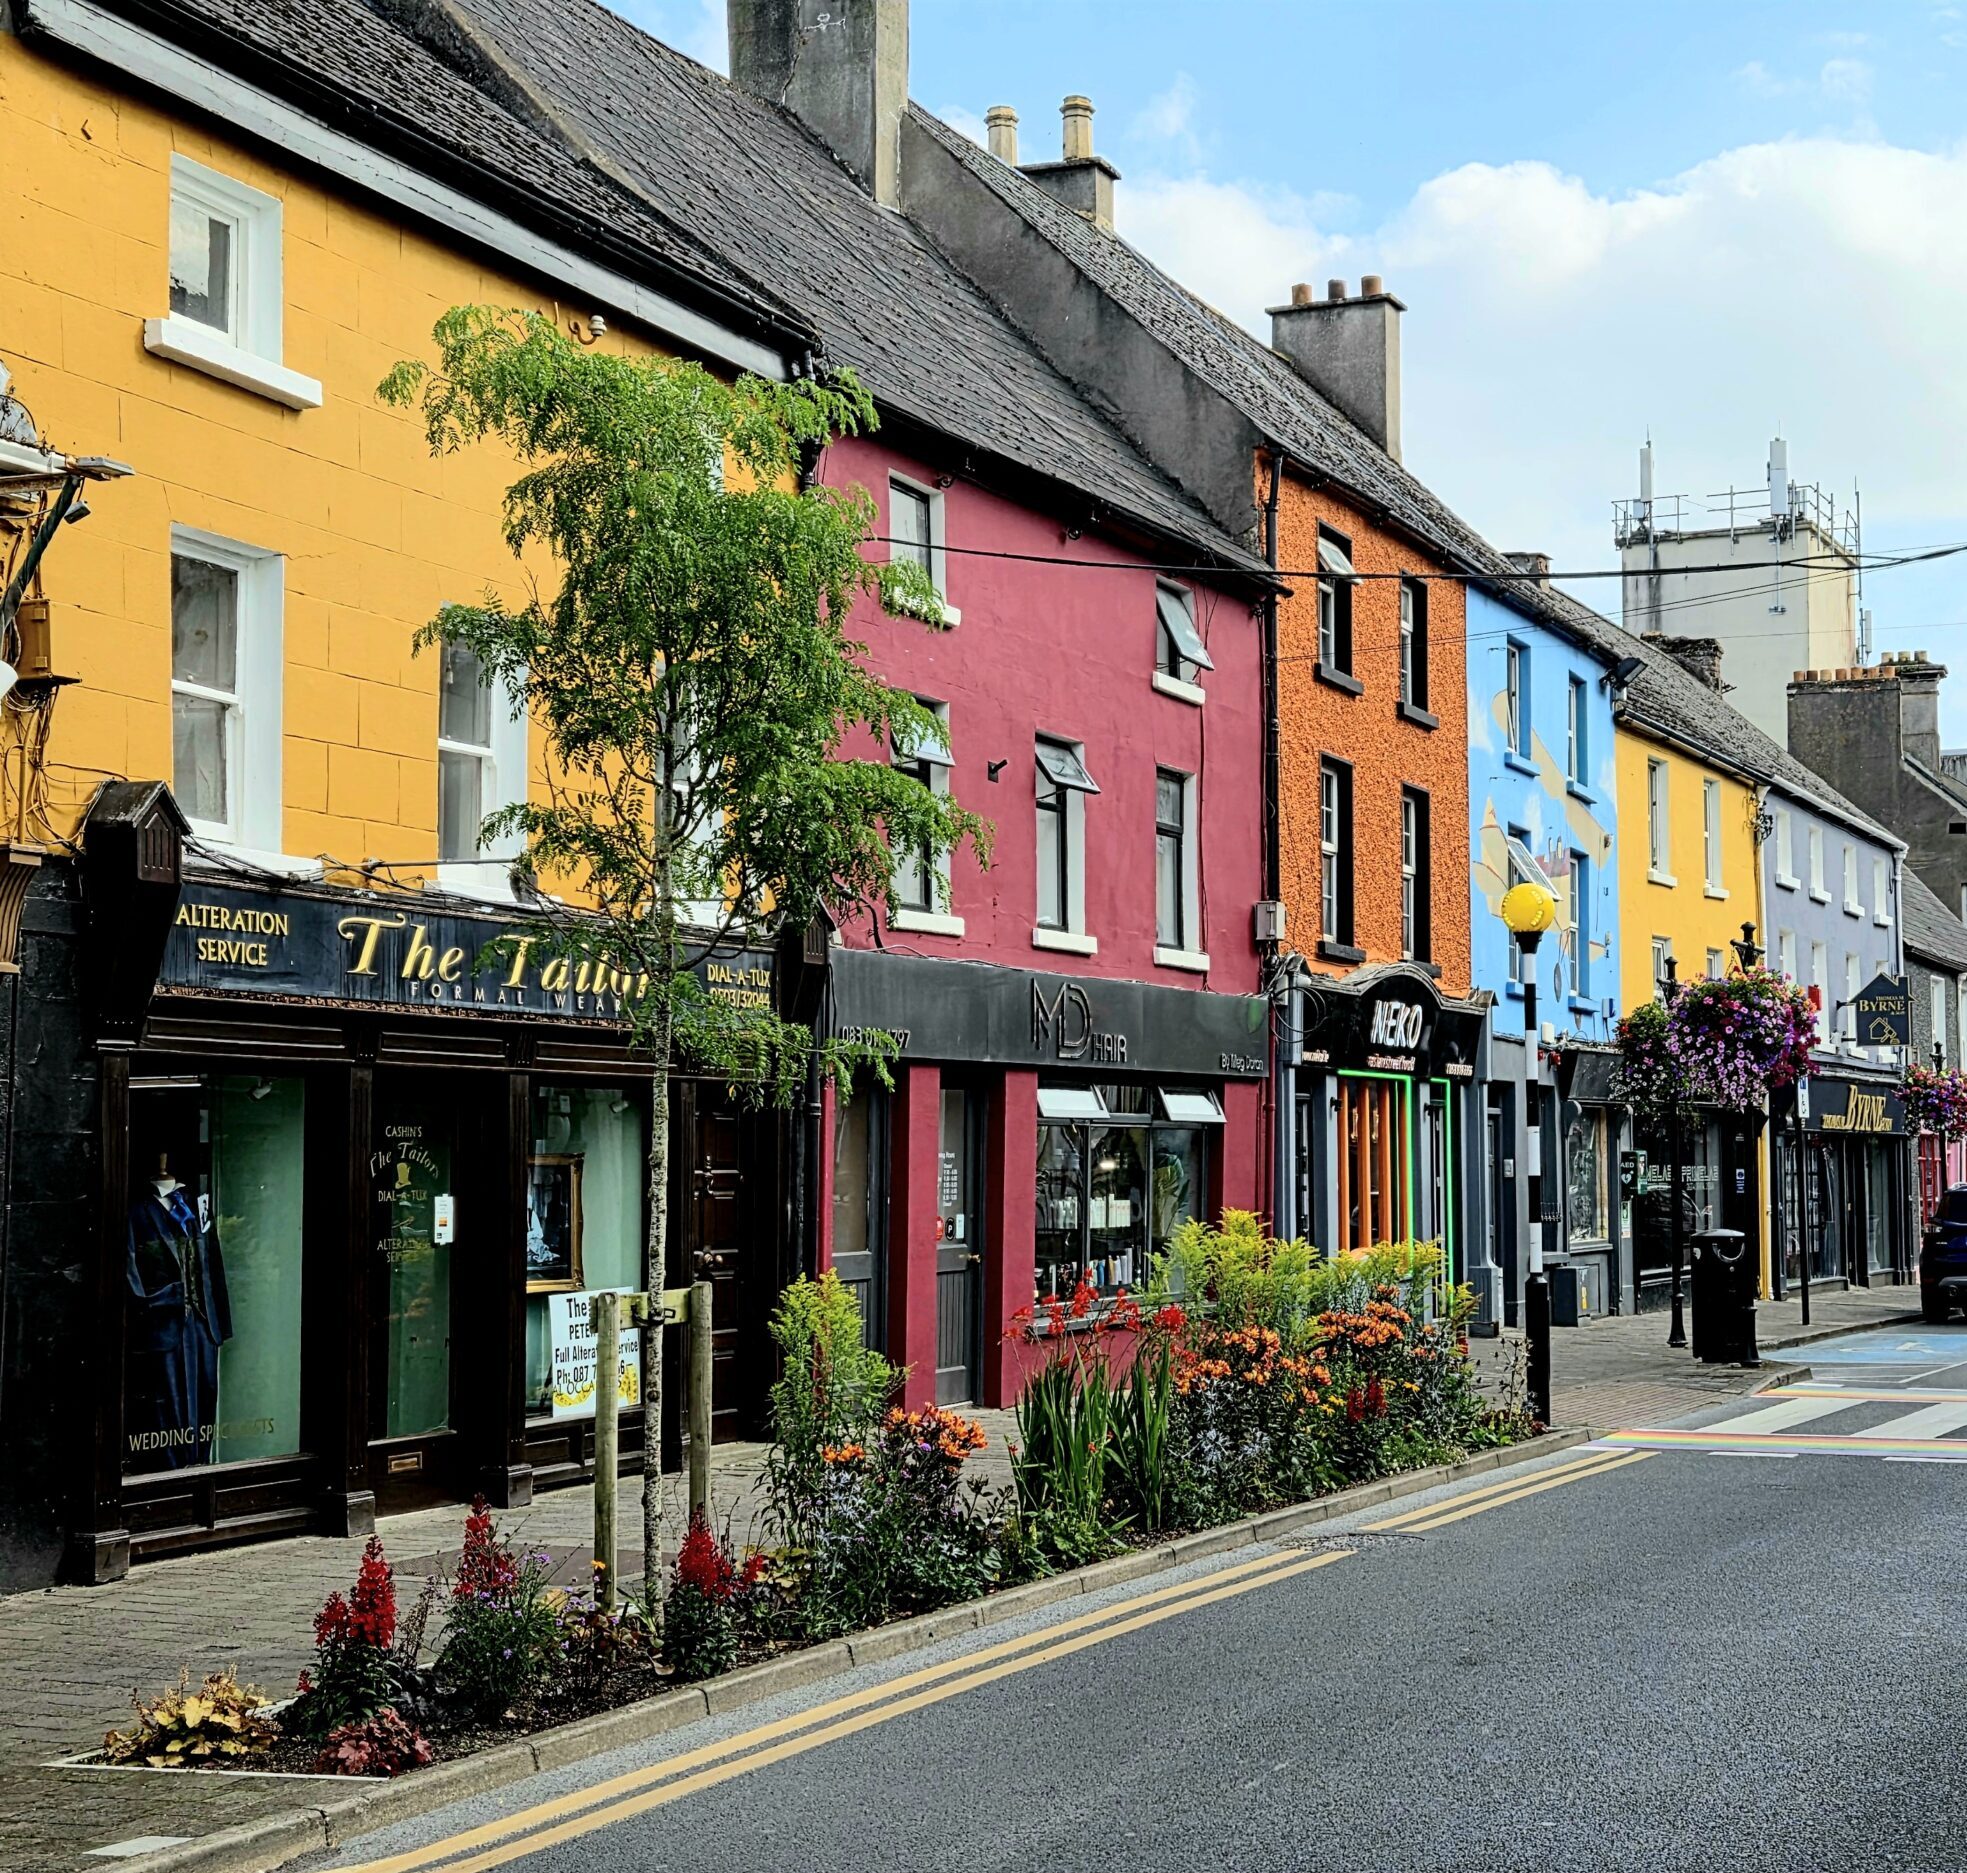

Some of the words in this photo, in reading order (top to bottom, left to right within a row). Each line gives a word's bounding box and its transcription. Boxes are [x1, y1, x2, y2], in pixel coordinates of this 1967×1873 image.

[176, 904, 289, 936] ALTERATION
[197, 938, 268, 966] SERVICE
[337, 913, 464, 982] The
[707, 964, 771, 988] DIAL-A-TUX
[410, 981, 525, 1006] FORMAL
[554, 993, 621, 1012] WEAR
[1859, 999, 1906, 1011] BYRNE
[1032, 978, 1092, 1058] MD
[1093, 1033, 1128, 1063] HAIR
[1370, 999, 1423, 1049] NEKO
[1844, 1084, 1887, 1132] BYRNE
[385, 1125, 423, 1138] CASHIN'S
[566, 1298, 588, 1319] The
[569, 1323, 595, 1340] PETE
[555, 1346, 570, 1364] Full
[572, 1345, 597, 1362] Altera
[128, 1426, 195, 1452] WEDDING
